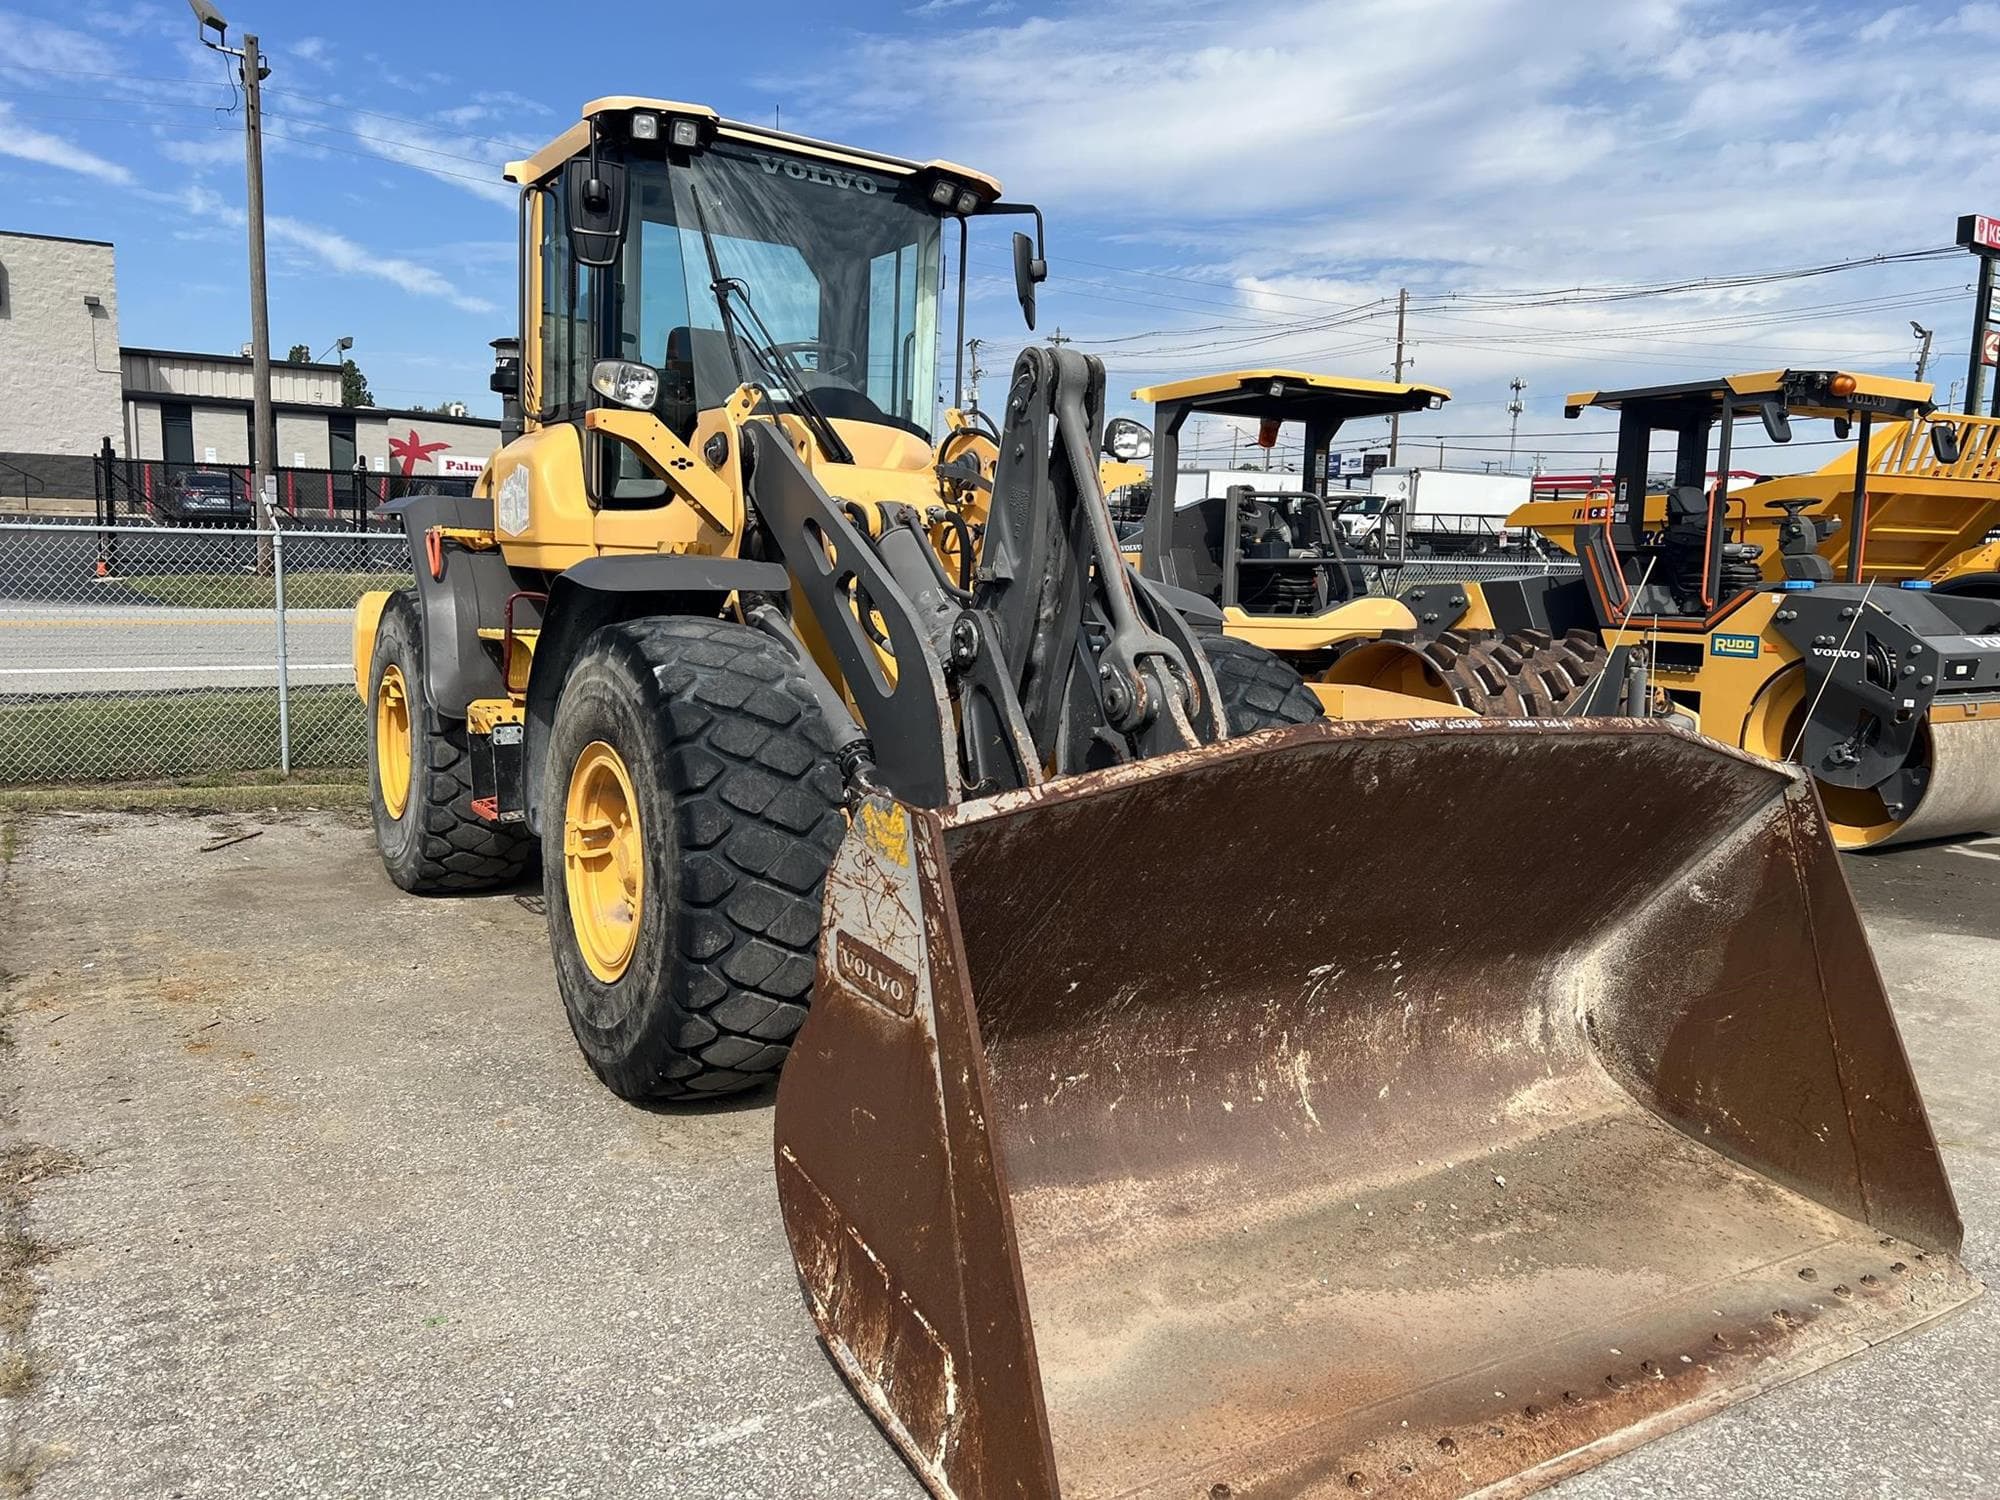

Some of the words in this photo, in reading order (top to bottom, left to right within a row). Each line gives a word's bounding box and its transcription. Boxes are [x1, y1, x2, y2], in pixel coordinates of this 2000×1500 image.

[751, 153, 878, 195] VOLVO
[1846, 393, 1887, 407] VOLVO
[445, 460, 483, 472] Palm
[1715, 638, 1755, 651] RUDD
[1812, 648, 1861, 659] VOLVO
[841, 947, 904, 1000] VOLVO
